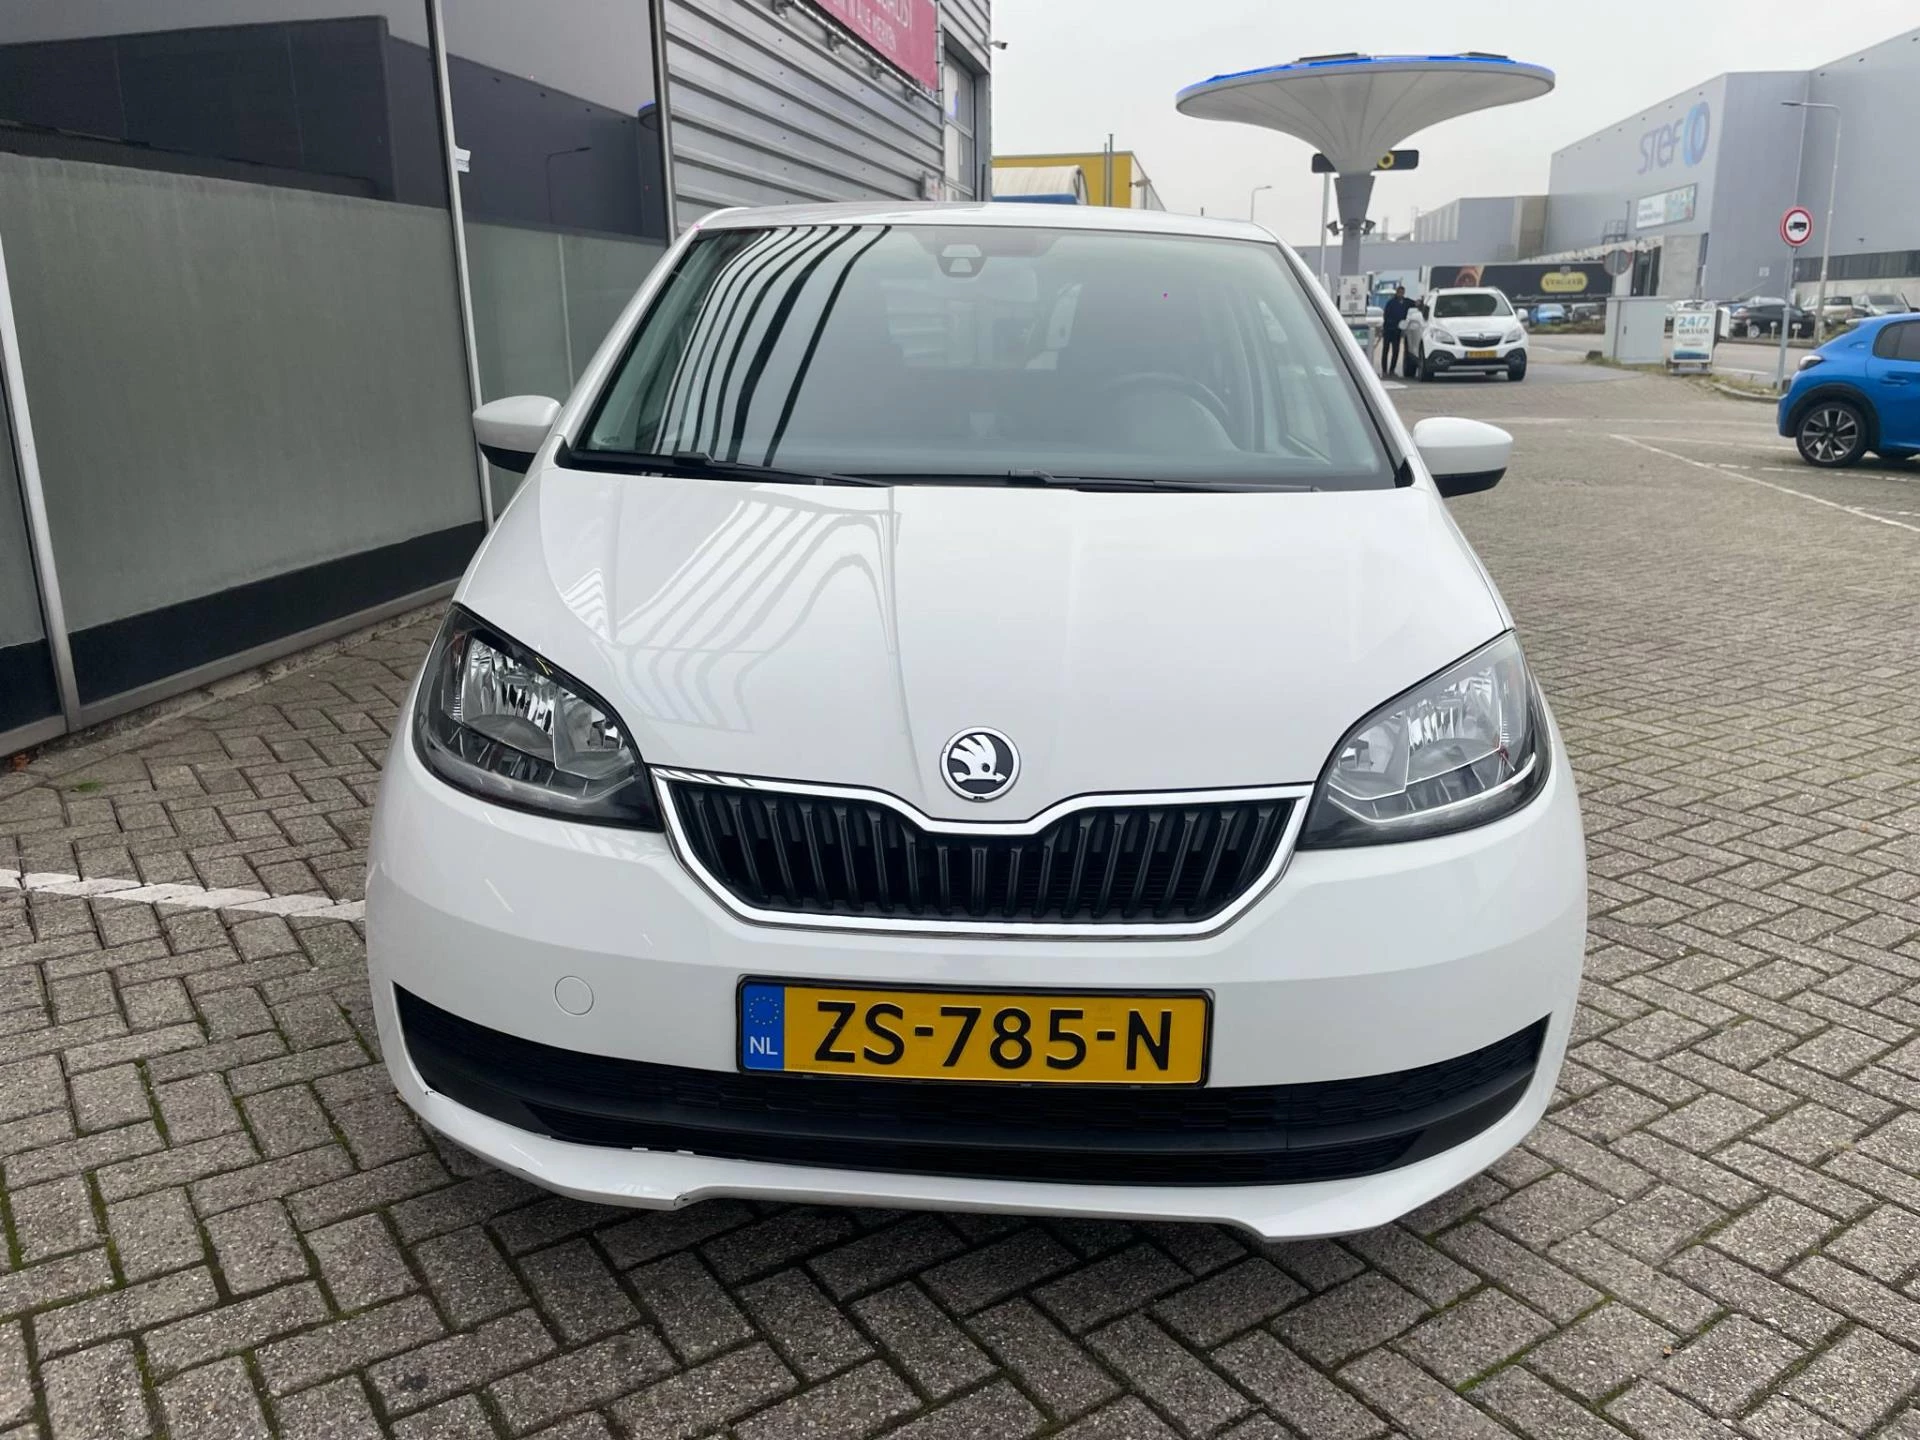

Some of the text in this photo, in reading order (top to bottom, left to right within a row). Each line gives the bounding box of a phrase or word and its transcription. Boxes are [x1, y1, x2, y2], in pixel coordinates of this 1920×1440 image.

[1678, 315, 1711, 328] 24/7
[749, 1035, 779, 1056] NL
[814, 1000, 1173, 1072] ZS-785-N
